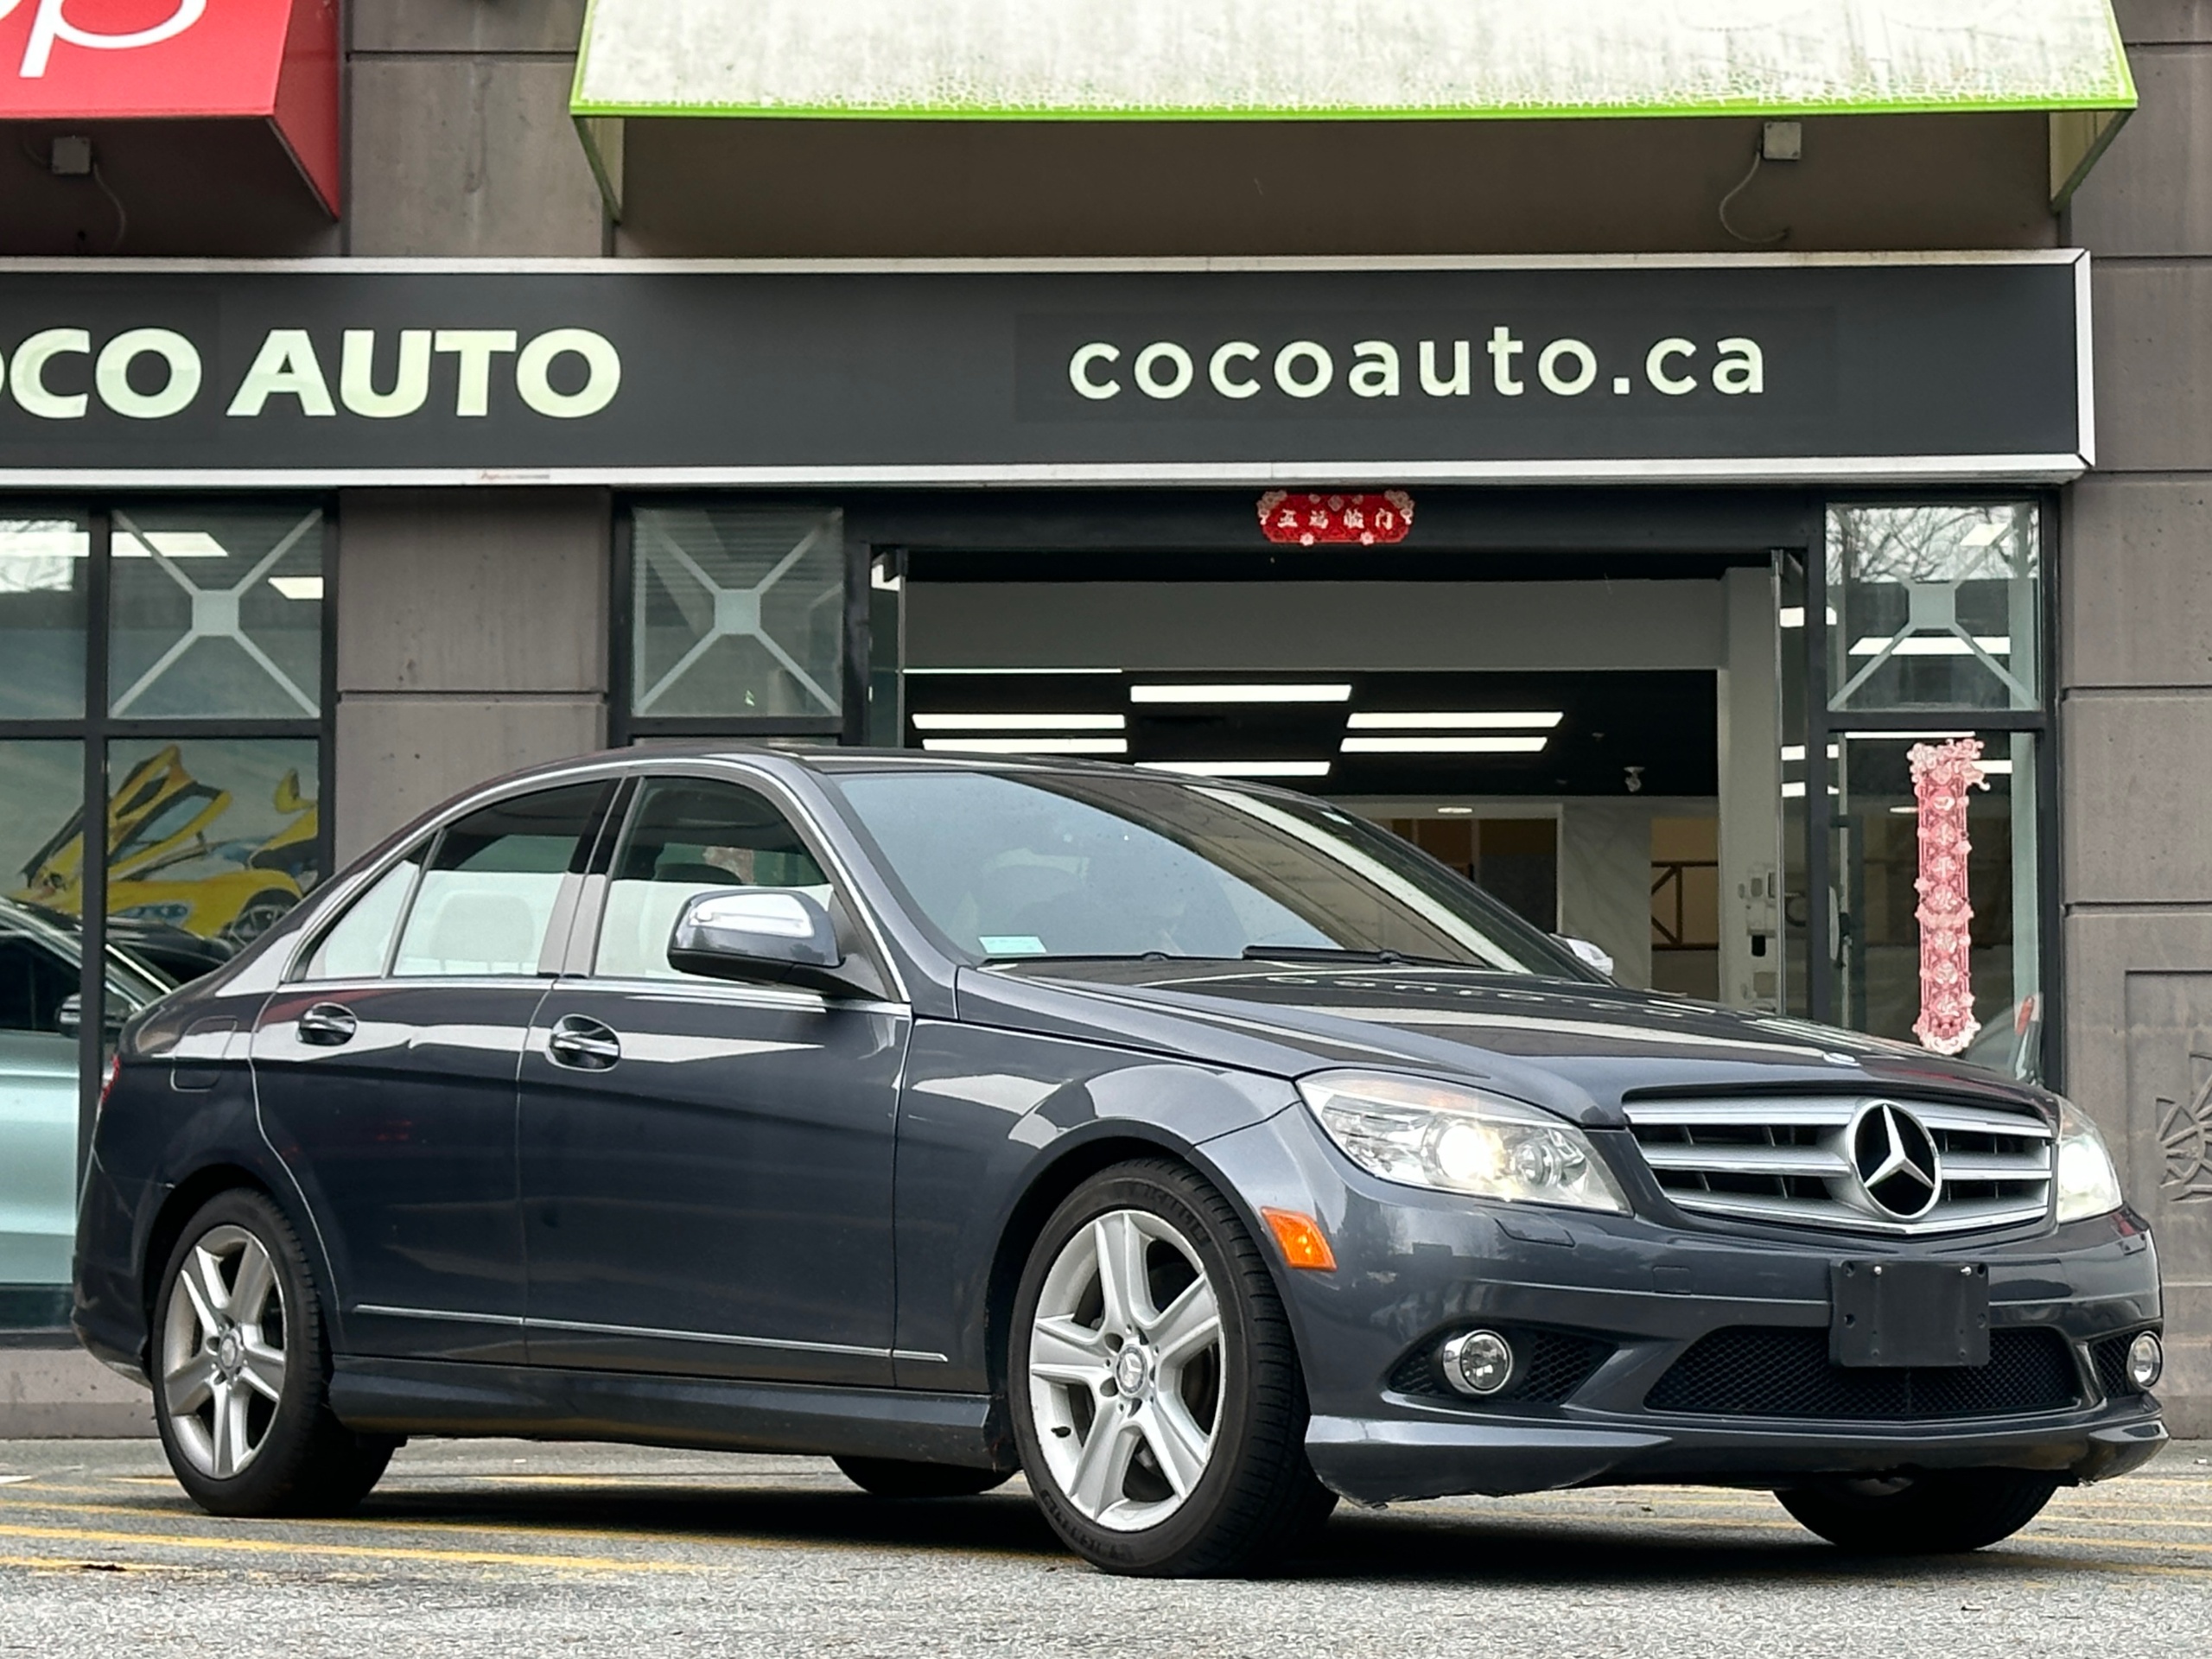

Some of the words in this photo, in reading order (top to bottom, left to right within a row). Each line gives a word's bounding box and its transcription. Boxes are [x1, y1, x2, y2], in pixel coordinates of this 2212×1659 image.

[0, 328, 201, 418] CO
[226, 328, 621, 418] AUTO
[1069, 326, 1764, 400] cocoauto.ca
